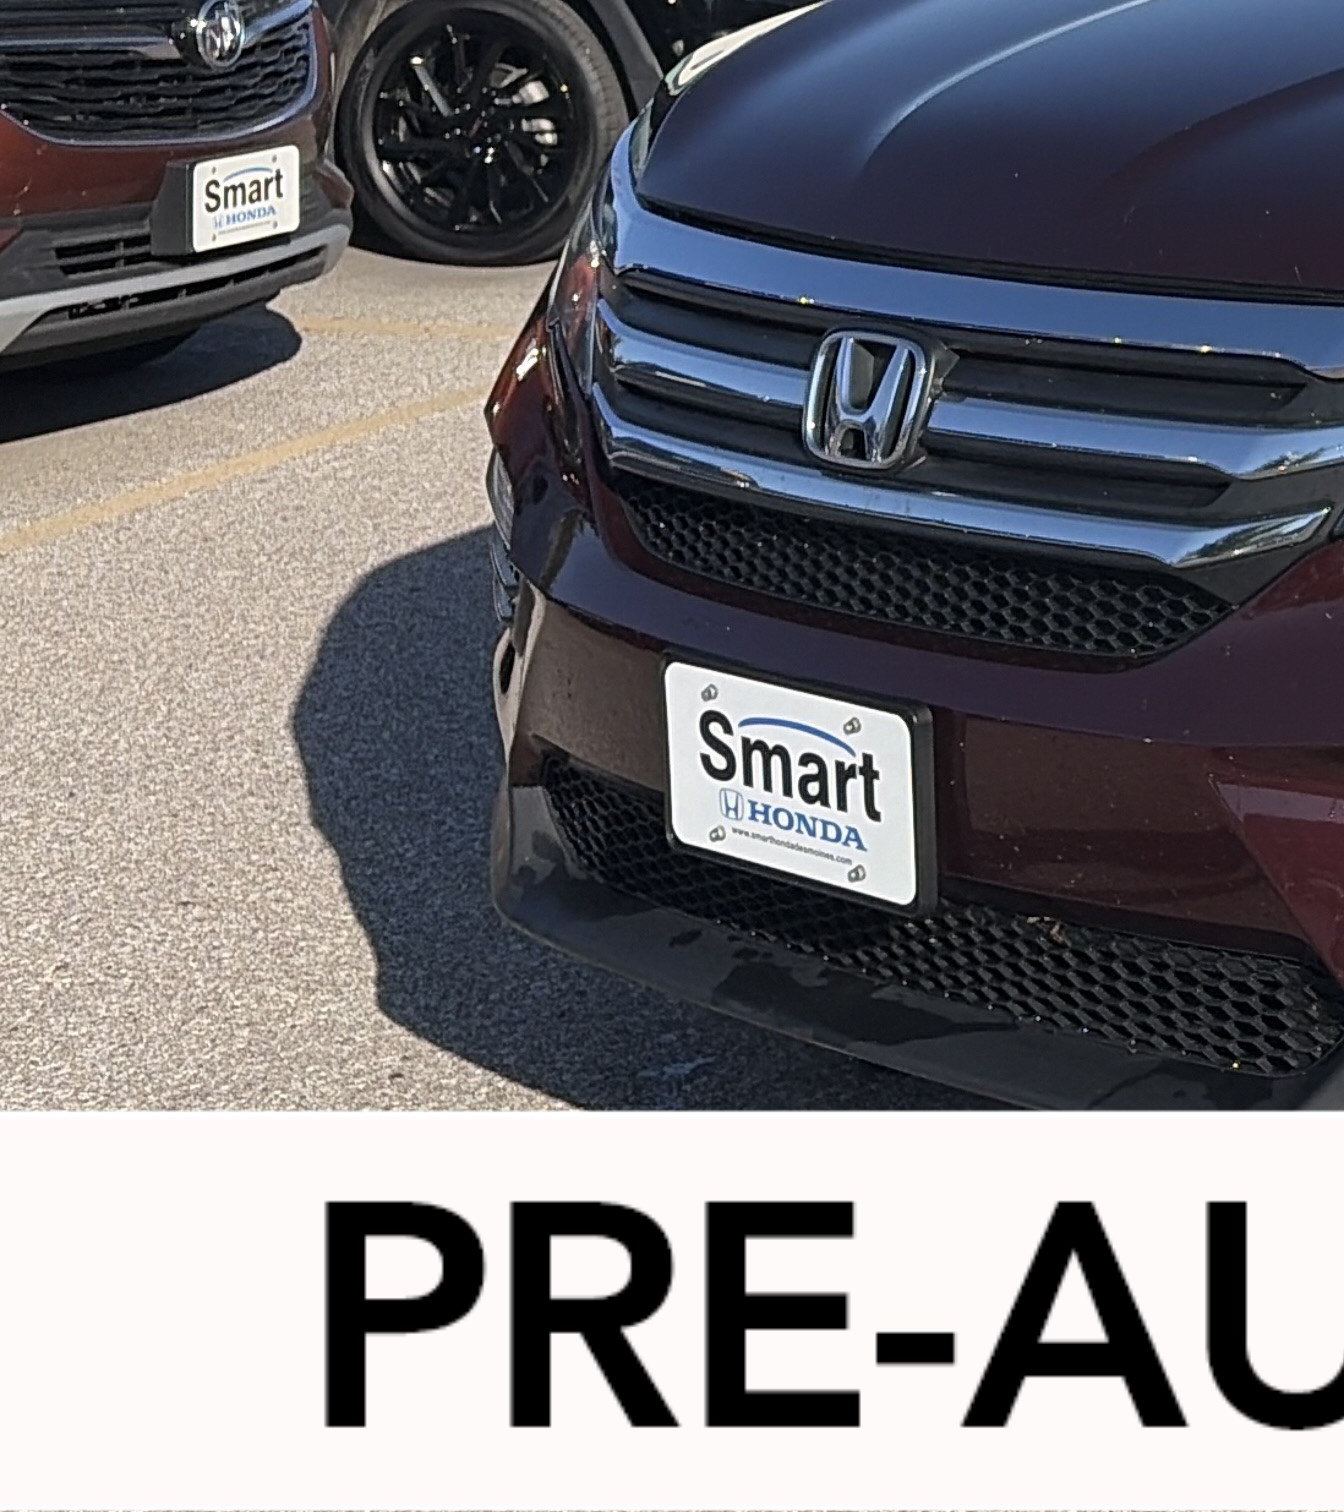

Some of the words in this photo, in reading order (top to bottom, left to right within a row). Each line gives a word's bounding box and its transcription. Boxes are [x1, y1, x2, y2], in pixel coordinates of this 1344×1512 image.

[204, 168, 284, 214] Smart
[225, 205, 277, 224] HONDA
[699, 709, 882, 823] Smart
[747, 799, 868, 852] HONDA
